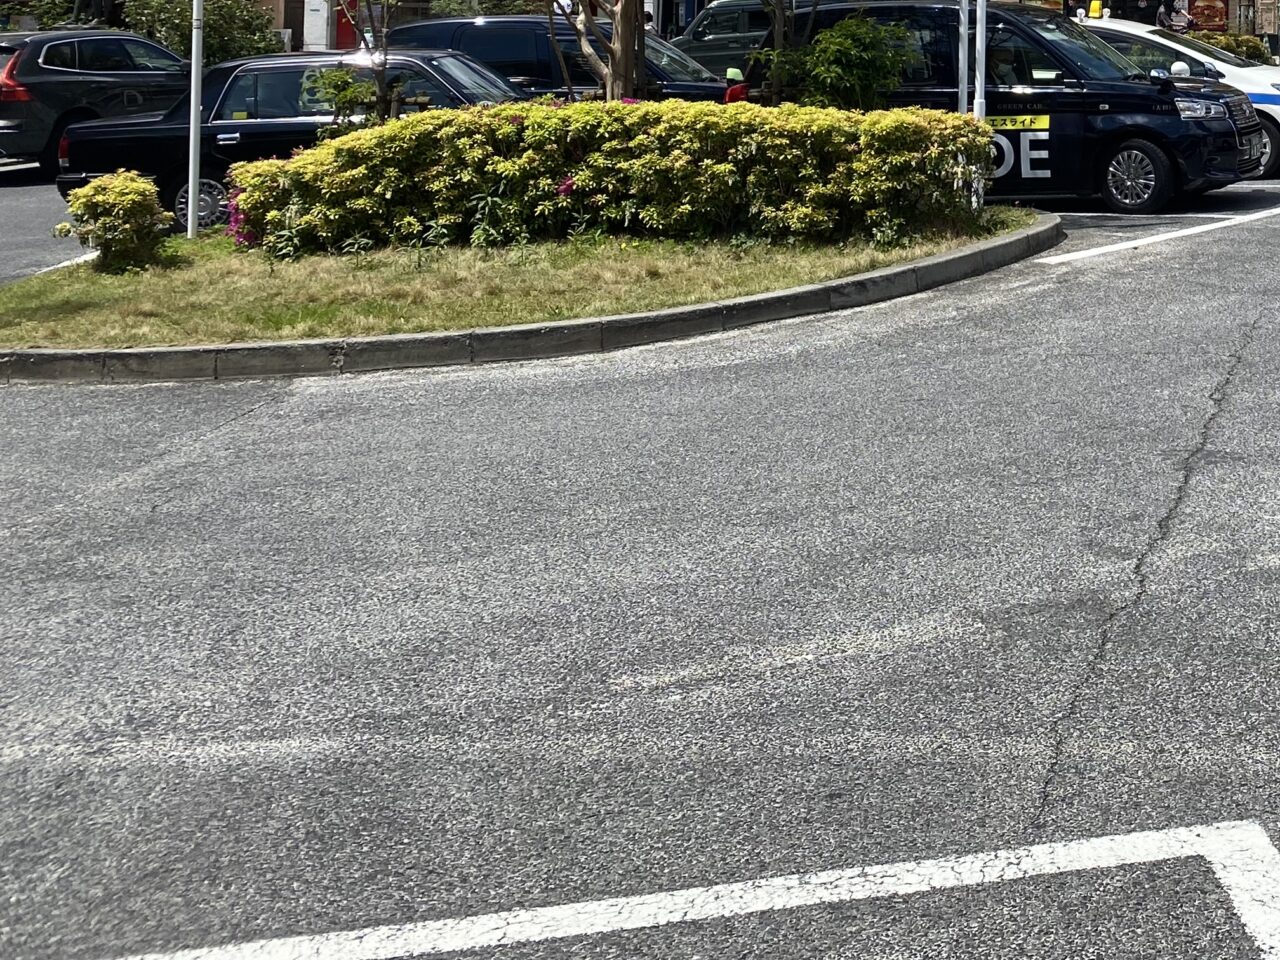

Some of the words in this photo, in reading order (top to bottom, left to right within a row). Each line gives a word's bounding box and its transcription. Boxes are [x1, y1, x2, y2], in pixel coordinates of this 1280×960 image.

[989, 117, 1037, 127] エスライド
